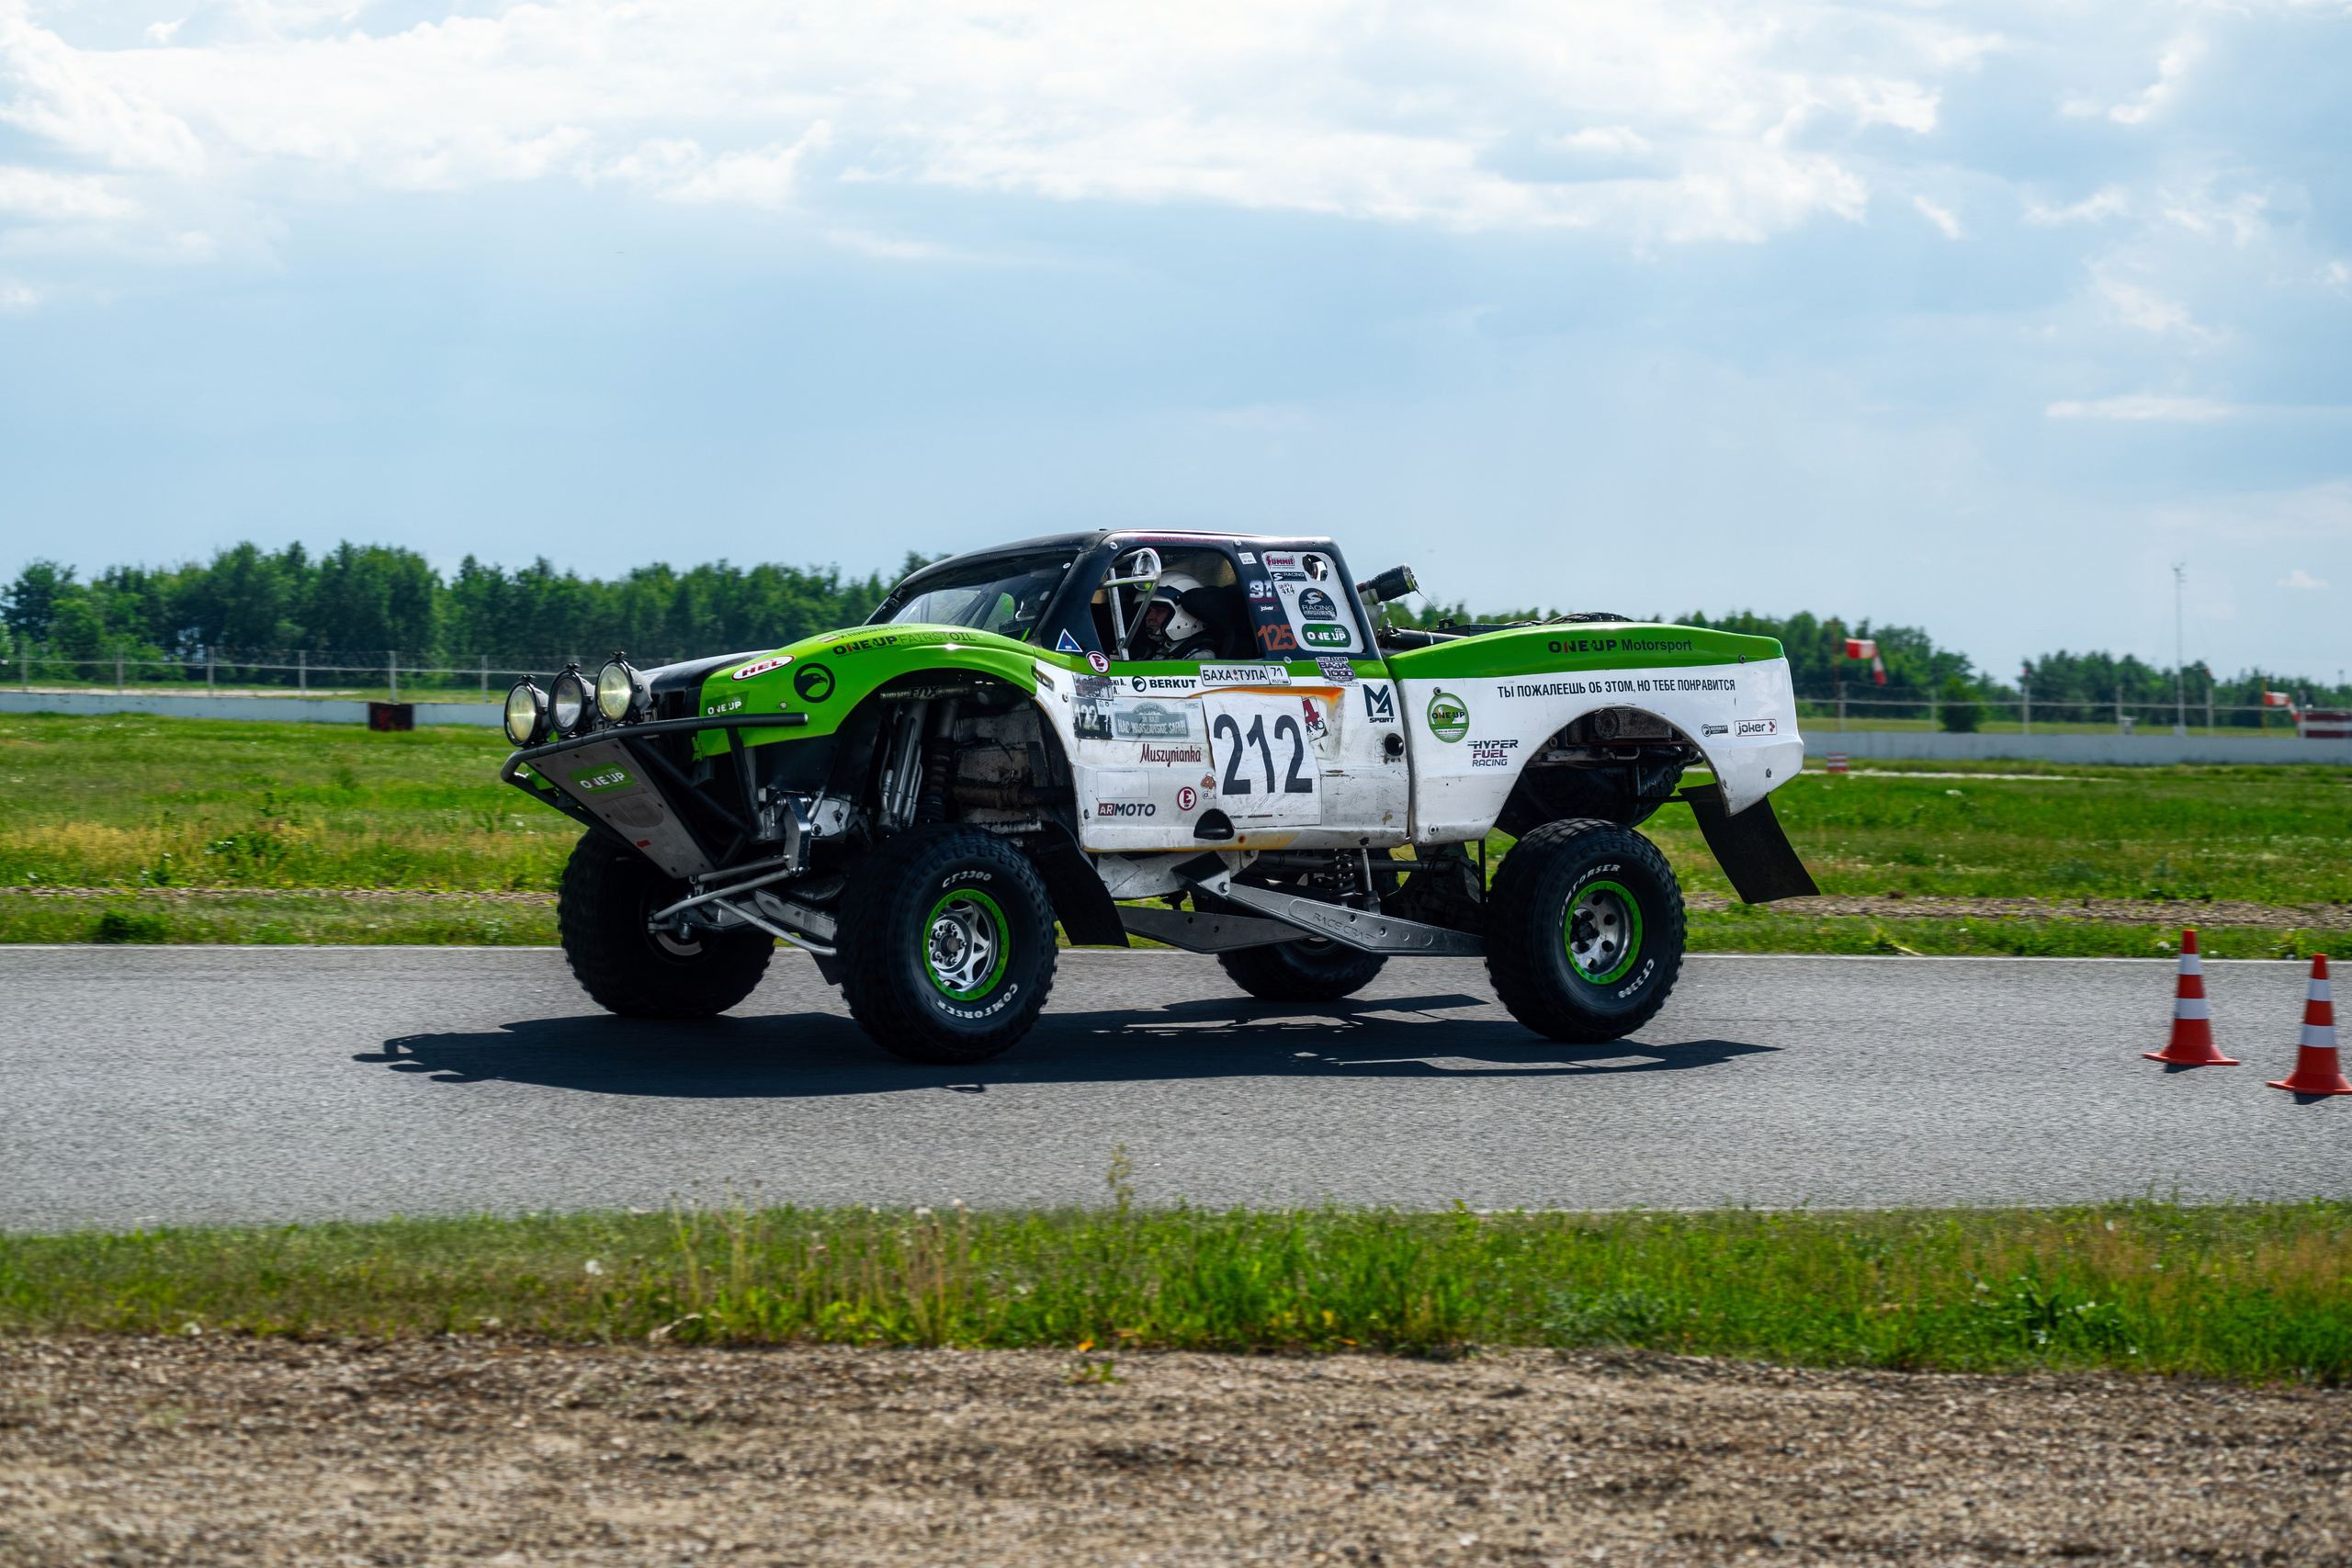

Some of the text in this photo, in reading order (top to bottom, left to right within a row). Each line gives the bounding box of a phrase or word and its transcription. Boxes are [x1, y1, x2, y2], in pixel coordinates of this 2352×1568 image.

[1257, 625, 1297, 650] 125
[1622, 638, 1692, 653] Motorsport
[742, 660, 782, 677] HEL
[1203, 667, 1283, 681] БАХА ТУЛА 71
[1149, 679, 1196, 689] BERKUT
[1498, 679, 1736, 698] ТЫ ПОЖАЛЕЕШЬ ОБ ЭТОМ, НО ТЕБЕ ПОНРАВИТСЯ
[1737, 722, 1766, 735] joker
[1467, 739, 1519, 749] HYPER
[1140, 743, 1201, 767] Muszynianka
[1214, 714, 1313, 795] 212
[1473, 750, 1508, 759] FUEL
[1472, 759, 1508, 767] RACING
[936, 983, 1019, 1019] COMFORSER
